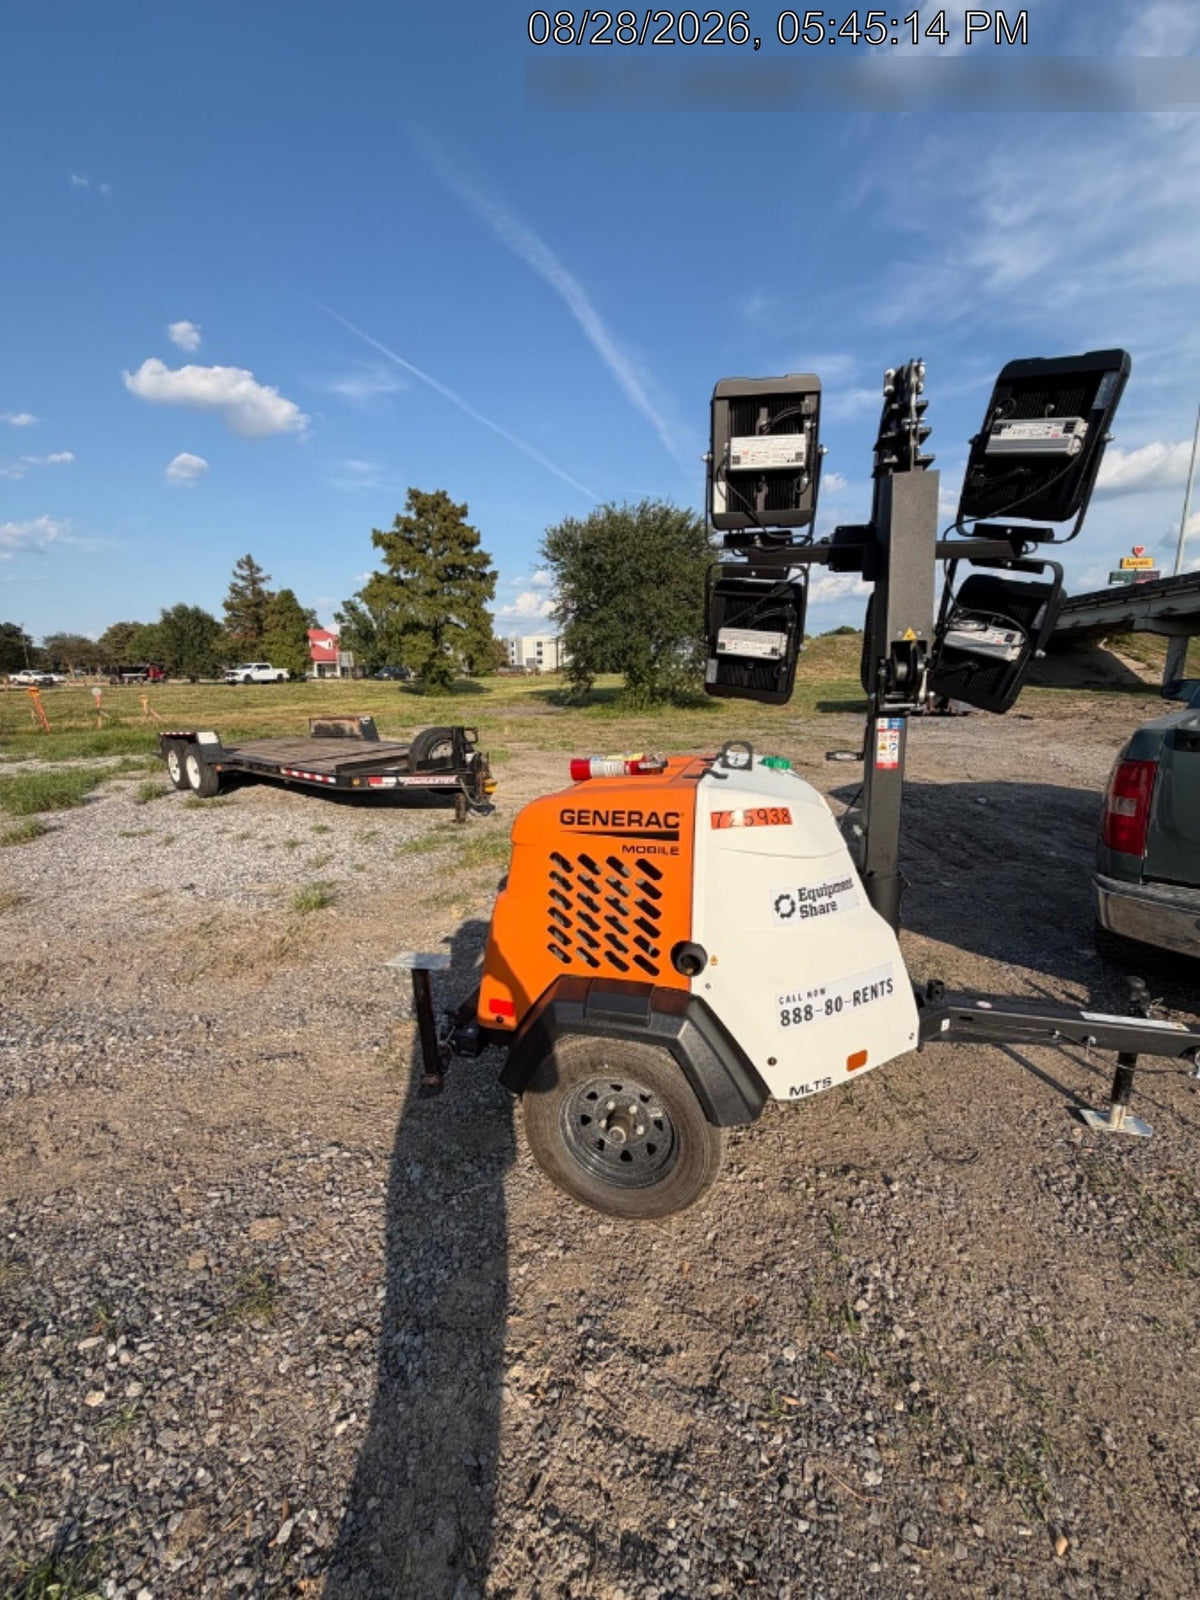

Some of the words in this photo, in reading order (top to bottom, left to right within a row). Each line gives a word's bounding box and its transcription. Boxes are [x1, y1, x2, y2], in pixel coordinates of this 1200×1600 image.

[559, 809, 681, 830] GENERAC
[621, 844, 680, 856] MOBILE
[797, 877, 854, 902] Equipment
[799, 900, 838, 919] Share
[778, 993, 803, 1005] CALL
[806, 987, 827, 999] NOW
[779, 977, 894, 1027] 888-80-RENTS
[789, 1076, 832, 1097] MLTS
